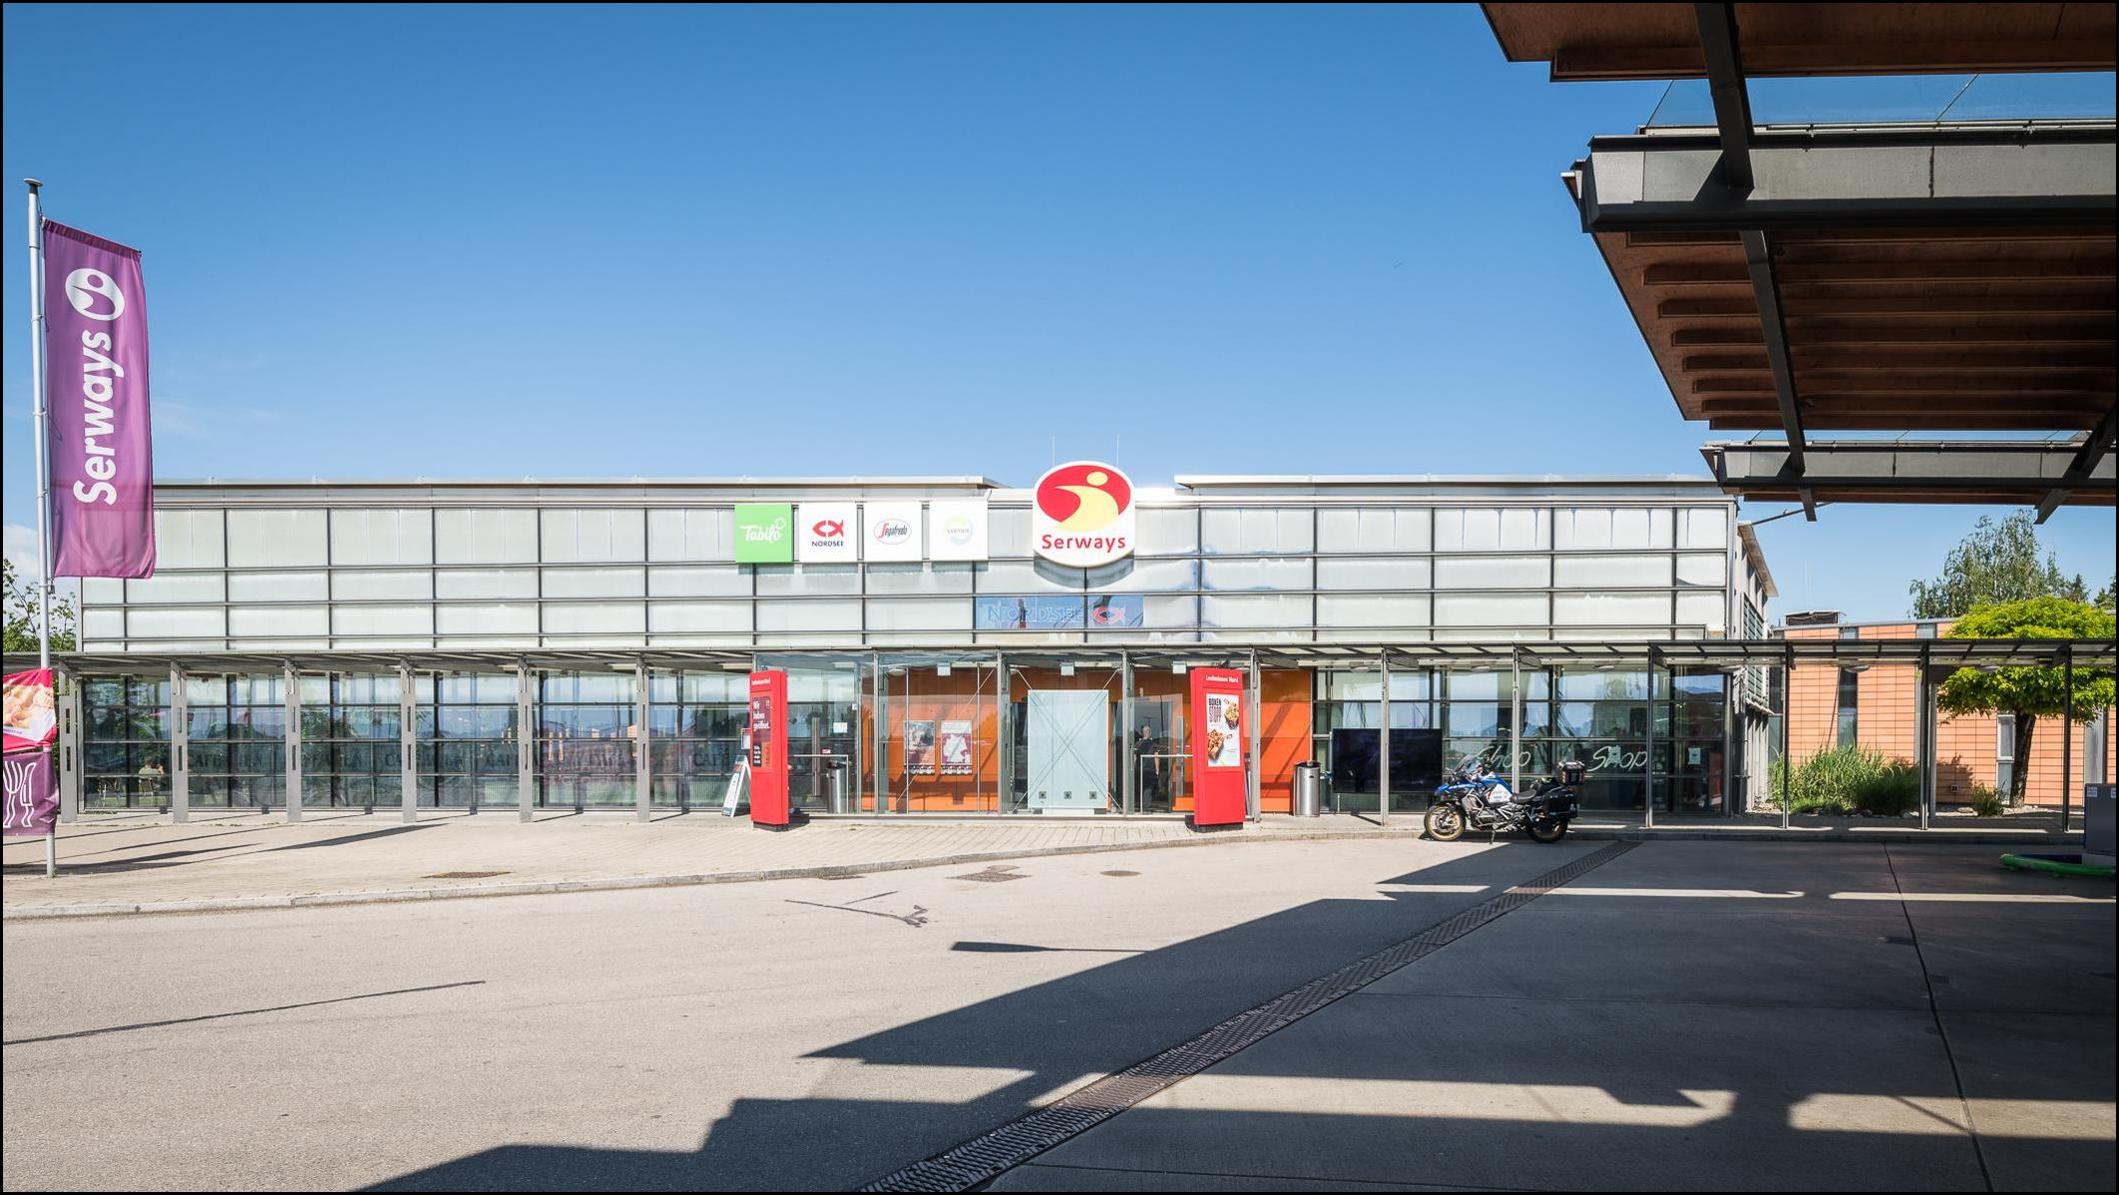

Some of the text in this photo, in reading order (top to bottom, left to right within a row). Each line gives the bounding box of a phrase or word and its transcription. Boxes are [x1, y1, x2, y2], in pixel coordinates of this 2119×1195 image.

[73, 329, 125, 506] Serways
[811, 540, 844, 548] NORDSEE
[1042, 534, 1126, 554] Serways
